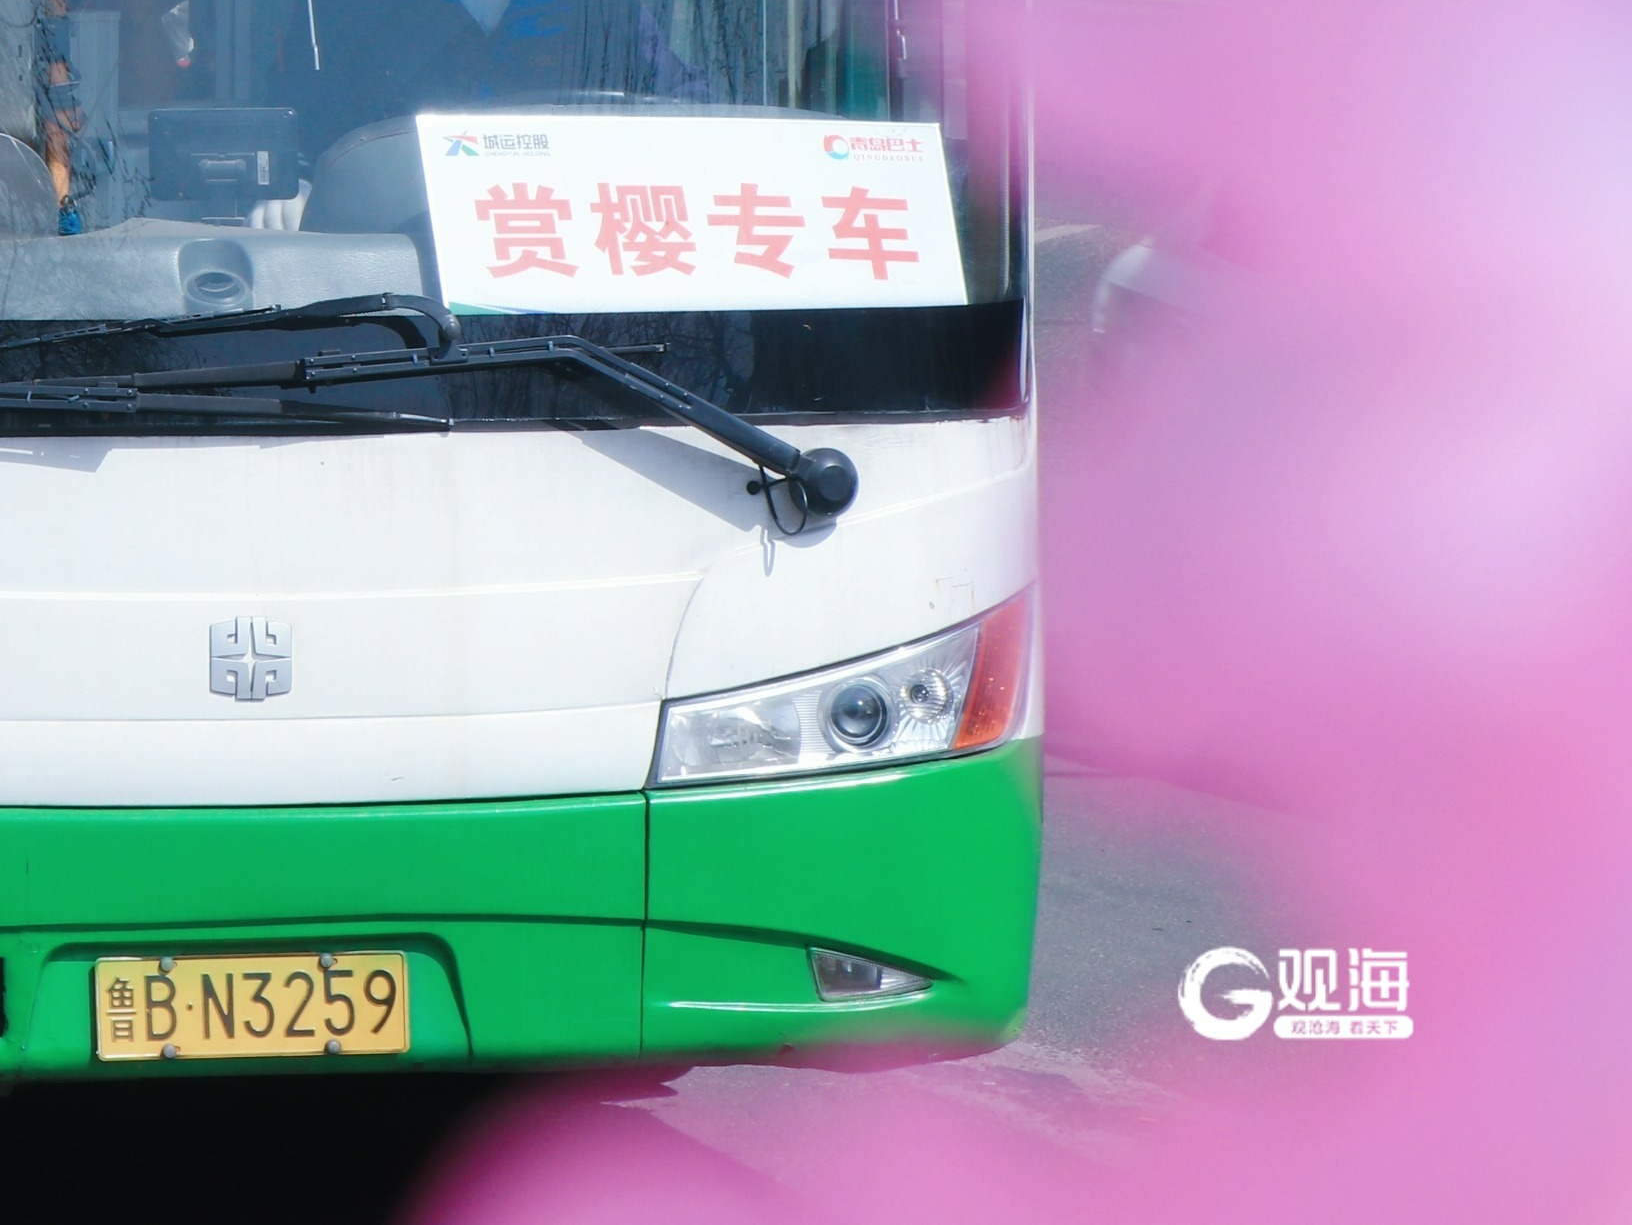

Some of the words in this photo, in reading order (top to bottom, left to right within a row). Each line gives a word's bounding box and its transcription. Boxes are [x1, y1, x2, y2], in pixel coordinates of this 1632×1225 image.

[482, 134, 550, 150] 城运控股
[849, 136, 924, 153] 青岛巴士
[474, 181, 920, 281] 赏樱专车
